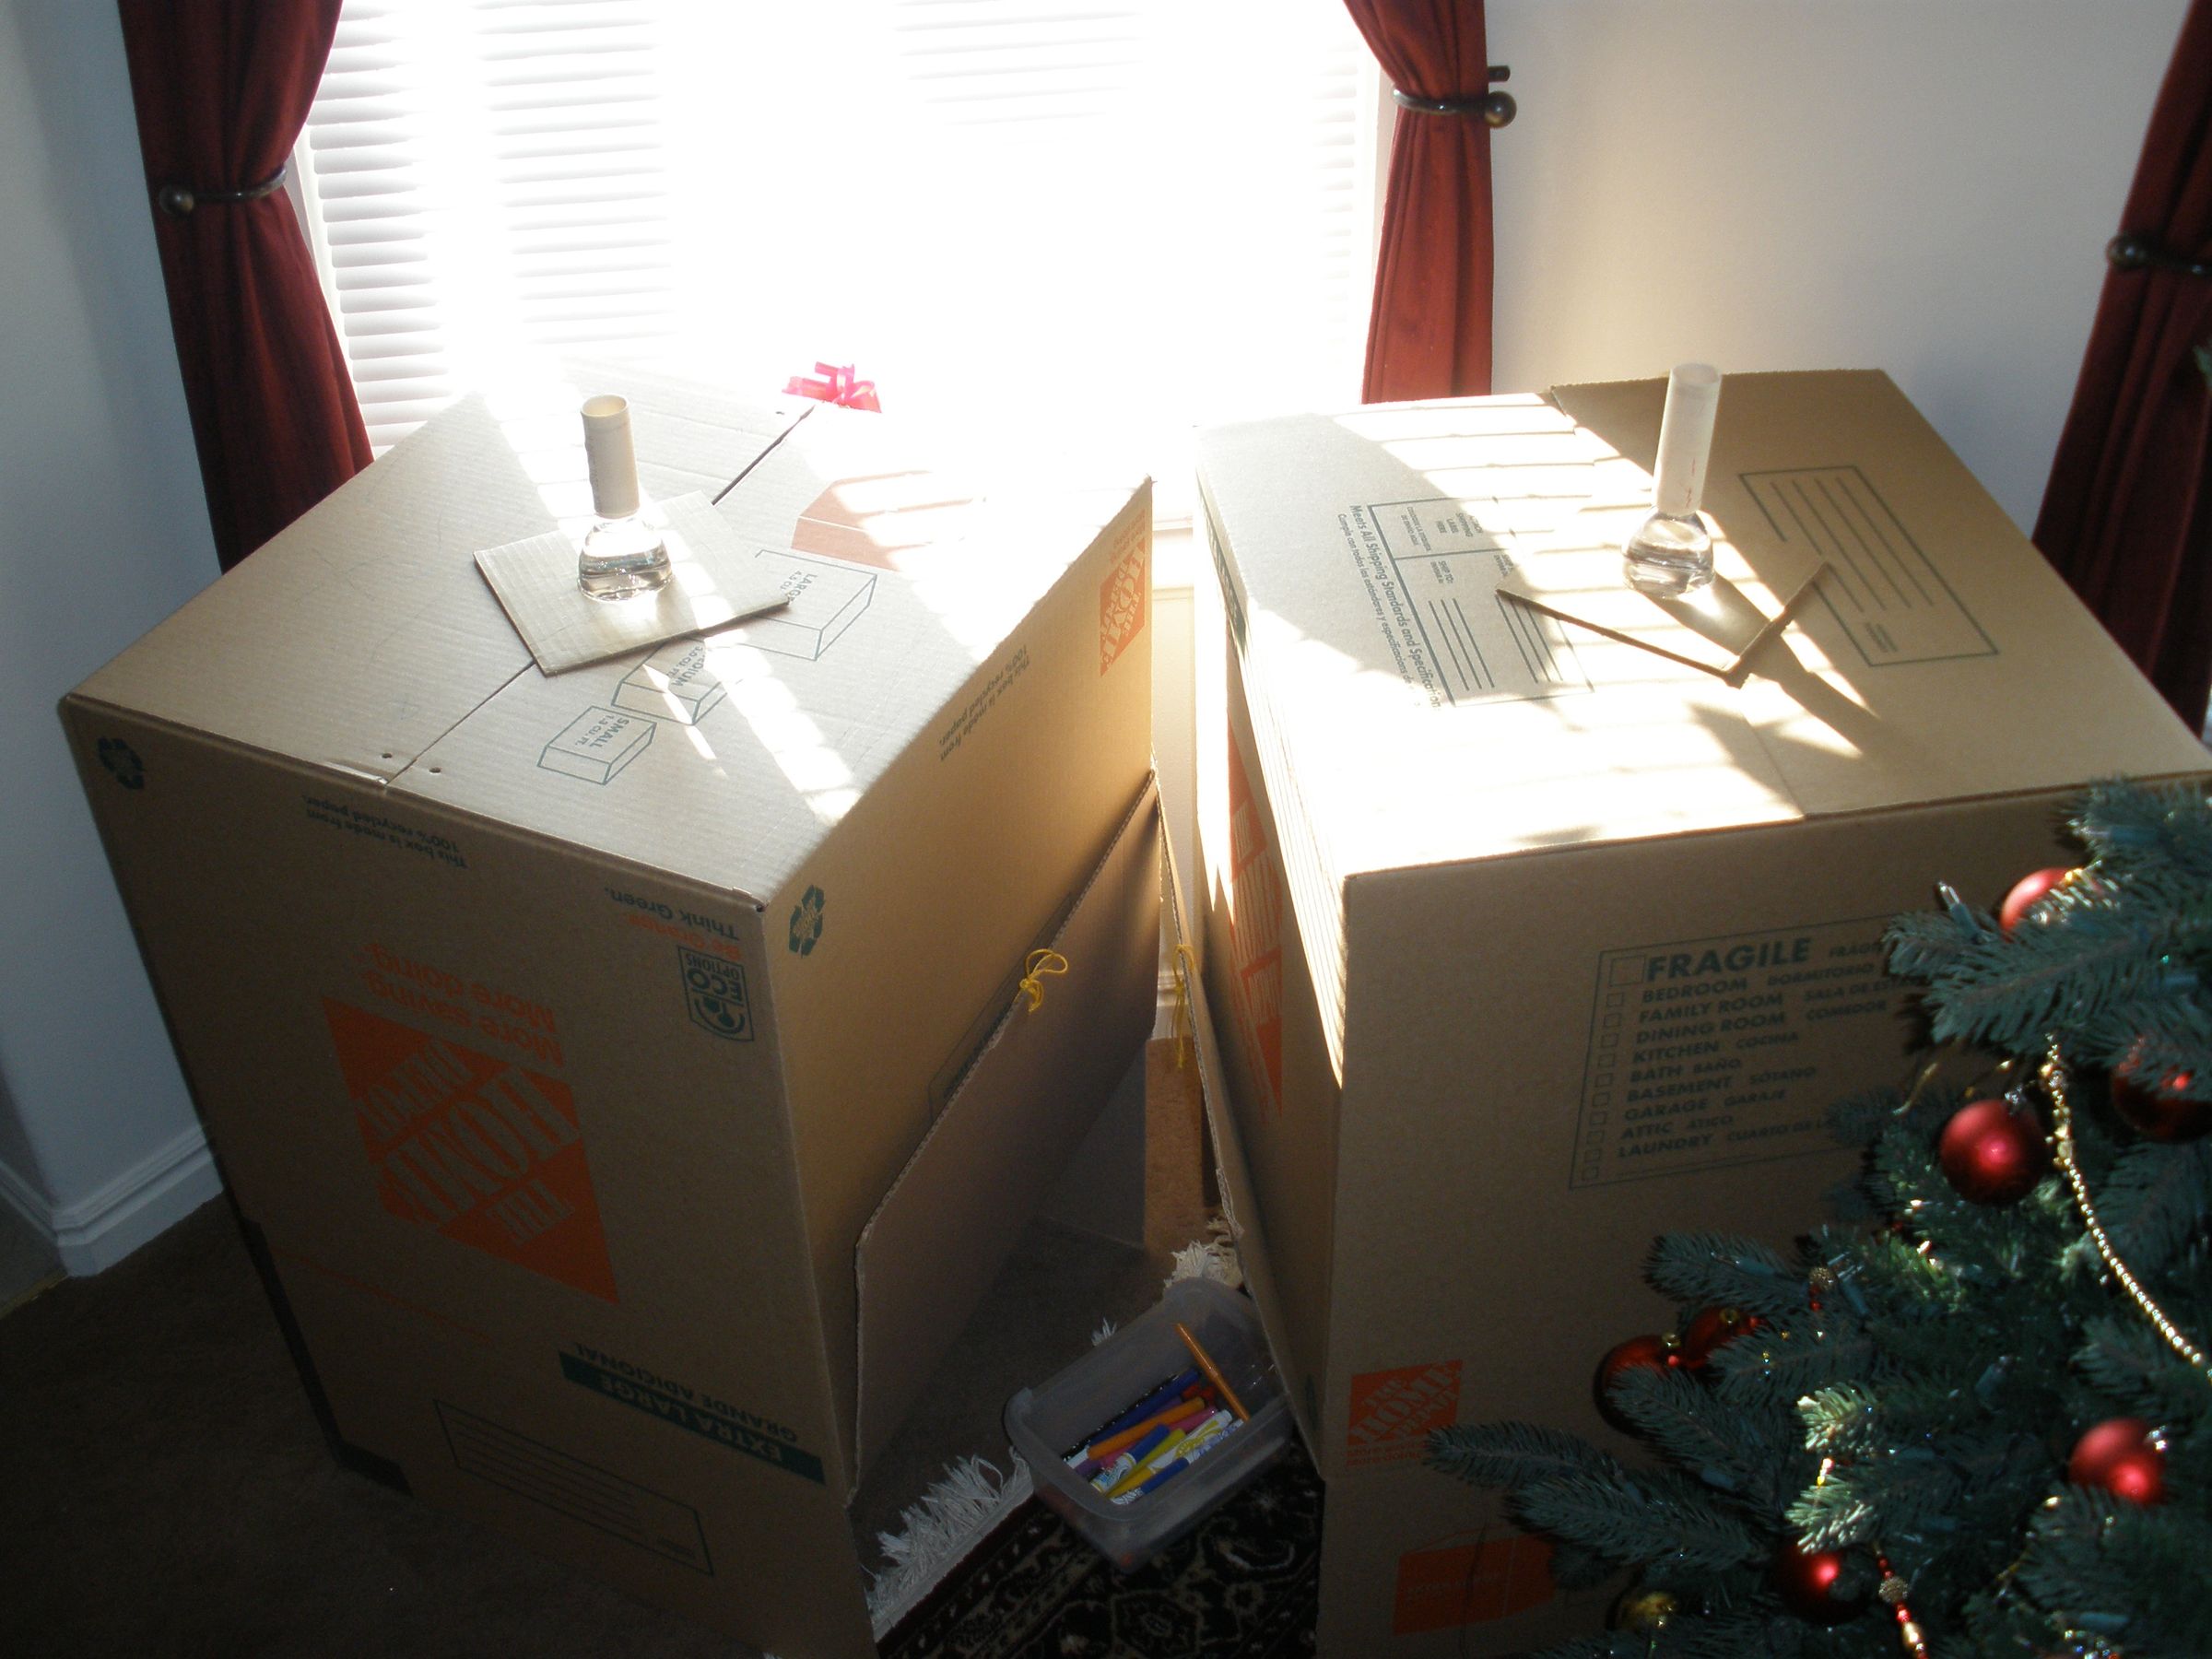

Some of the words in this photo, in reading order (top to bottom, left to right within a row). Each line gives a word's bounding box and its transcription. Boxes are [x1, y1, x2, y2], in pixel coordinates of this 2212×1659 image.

[1348, 504, 1368, 535] Meets
[1365, 540, 1388, 582] Shipping
[1382, 578, 1408, 628] Standards
[1401, 626, 1417, 648] and
[1101, 546, 1145, 664] HOME
[589, 717, 630, 748] SMALL
[604, 886, 674, 920] Green.
[678, 909, 740, 941] Think
[685, 952, 741, 982] OPTIONS
[712, 937, 742, 961] Be
[1647, 936, 1814, 982] FRAGILE
[686, 967, 743, 1002] ECO
[1641, 977, 1748, 1005] BEDROOM
[1767, 962, 1876, 987] DORMITORIO
[470, 981, 557, 1033] More
[1635, 1022, 1714, 1045] DINING
[1720, 1012, 1786, 1033] ROOM
[1805, 999, 1888, 1022] COMEDOR
[1638, 1001, 1712, 1025] FAMILY
[1718, 993, 1784, 1014] ROOM
[477, 1016, 564, 1069] More
[1631, 1041, 1720, 1065] KITCHEN
[1735, 1030, 1800, 1051] COCINA
[354, 1046, 482, 1140] DEPOT
[1626, 1075, 1734, 1103] BASEMENT
[1630, 1065, 1683, 1084] BATH
[1624, 1097, 1710, 1121] GARAGE
[1723, 1088, 1786, 1108] GARAJE
[376, 1067, 581, 1221] HOME
[1617, 1133, 1714, 1159] LAUNDRY
[1621, 1121, 1673, 1140] ATTIC
[486, 1178, 575, 1249] THE
[572, 1342, 696, 1402] ADICIONAL
[1363, 1379, 1404, 1407] THE
[599, 1373, 689, 1425] LARGE
[700, 1392, 798, 1444] GRANDE
[1349, 1370, 1453, 1443] HOME
[696, 1412, 782, 1463] EXTRA
